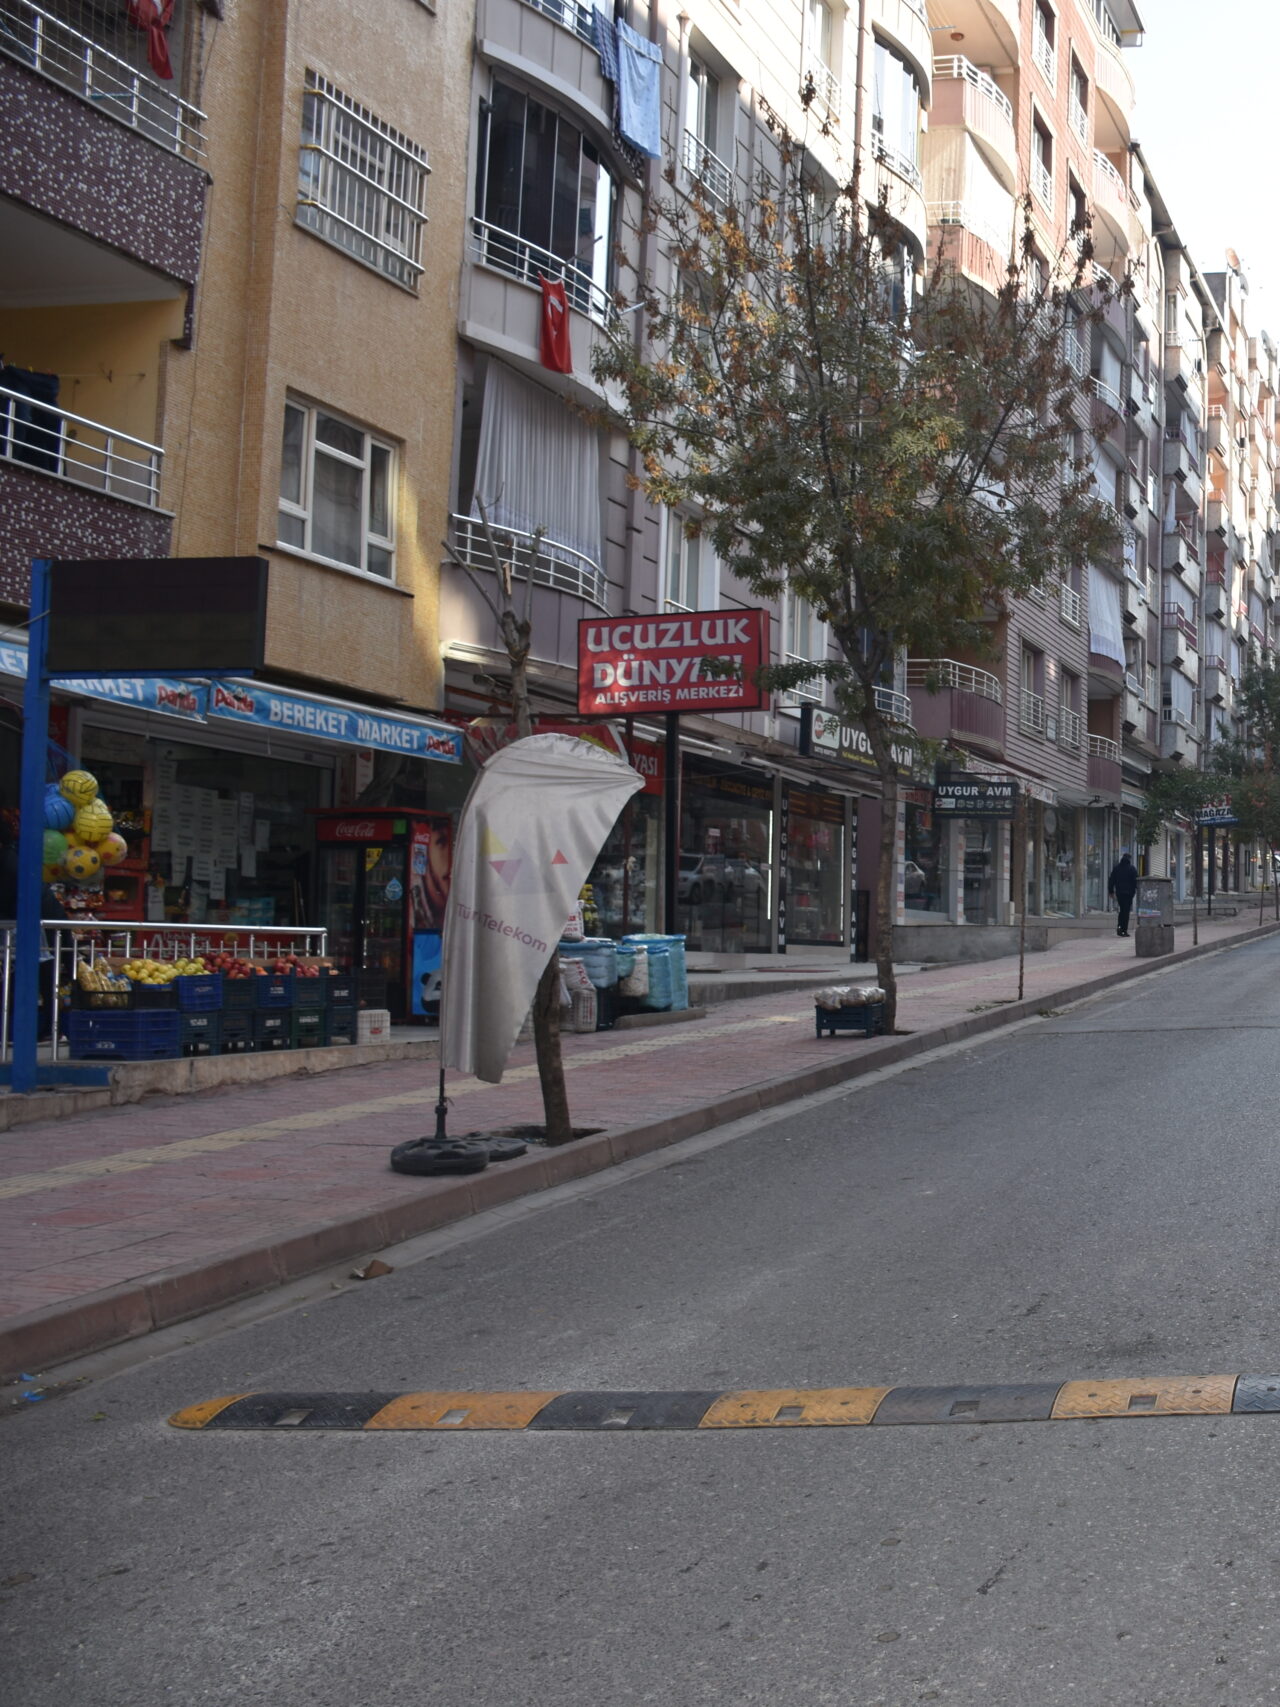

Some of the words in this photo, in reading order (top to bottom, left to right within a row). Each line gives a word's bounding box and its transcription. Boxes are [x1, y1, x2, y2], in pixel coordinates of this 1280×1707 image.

[586, 617, 752, 654] UCUZLUK
[594, 686, 671, 706] ALIŞVERİŞ
[675, 681, 744, 701] MERKEZİ
[268, 698, 349, 736] BEREKET
[356, 718, 421, 750] MARKET
[841, 726, 874, 755] UYGU
[632, 752, 658, 777] YASI
[938, 785, 979, 797] UYGUR
[986, 785, 1012, 797] AVM
[778, 800, 788, 879] UYGUR
[482, 913, 548, 953] Telekom
[777, 899, 786, 946] AVM
